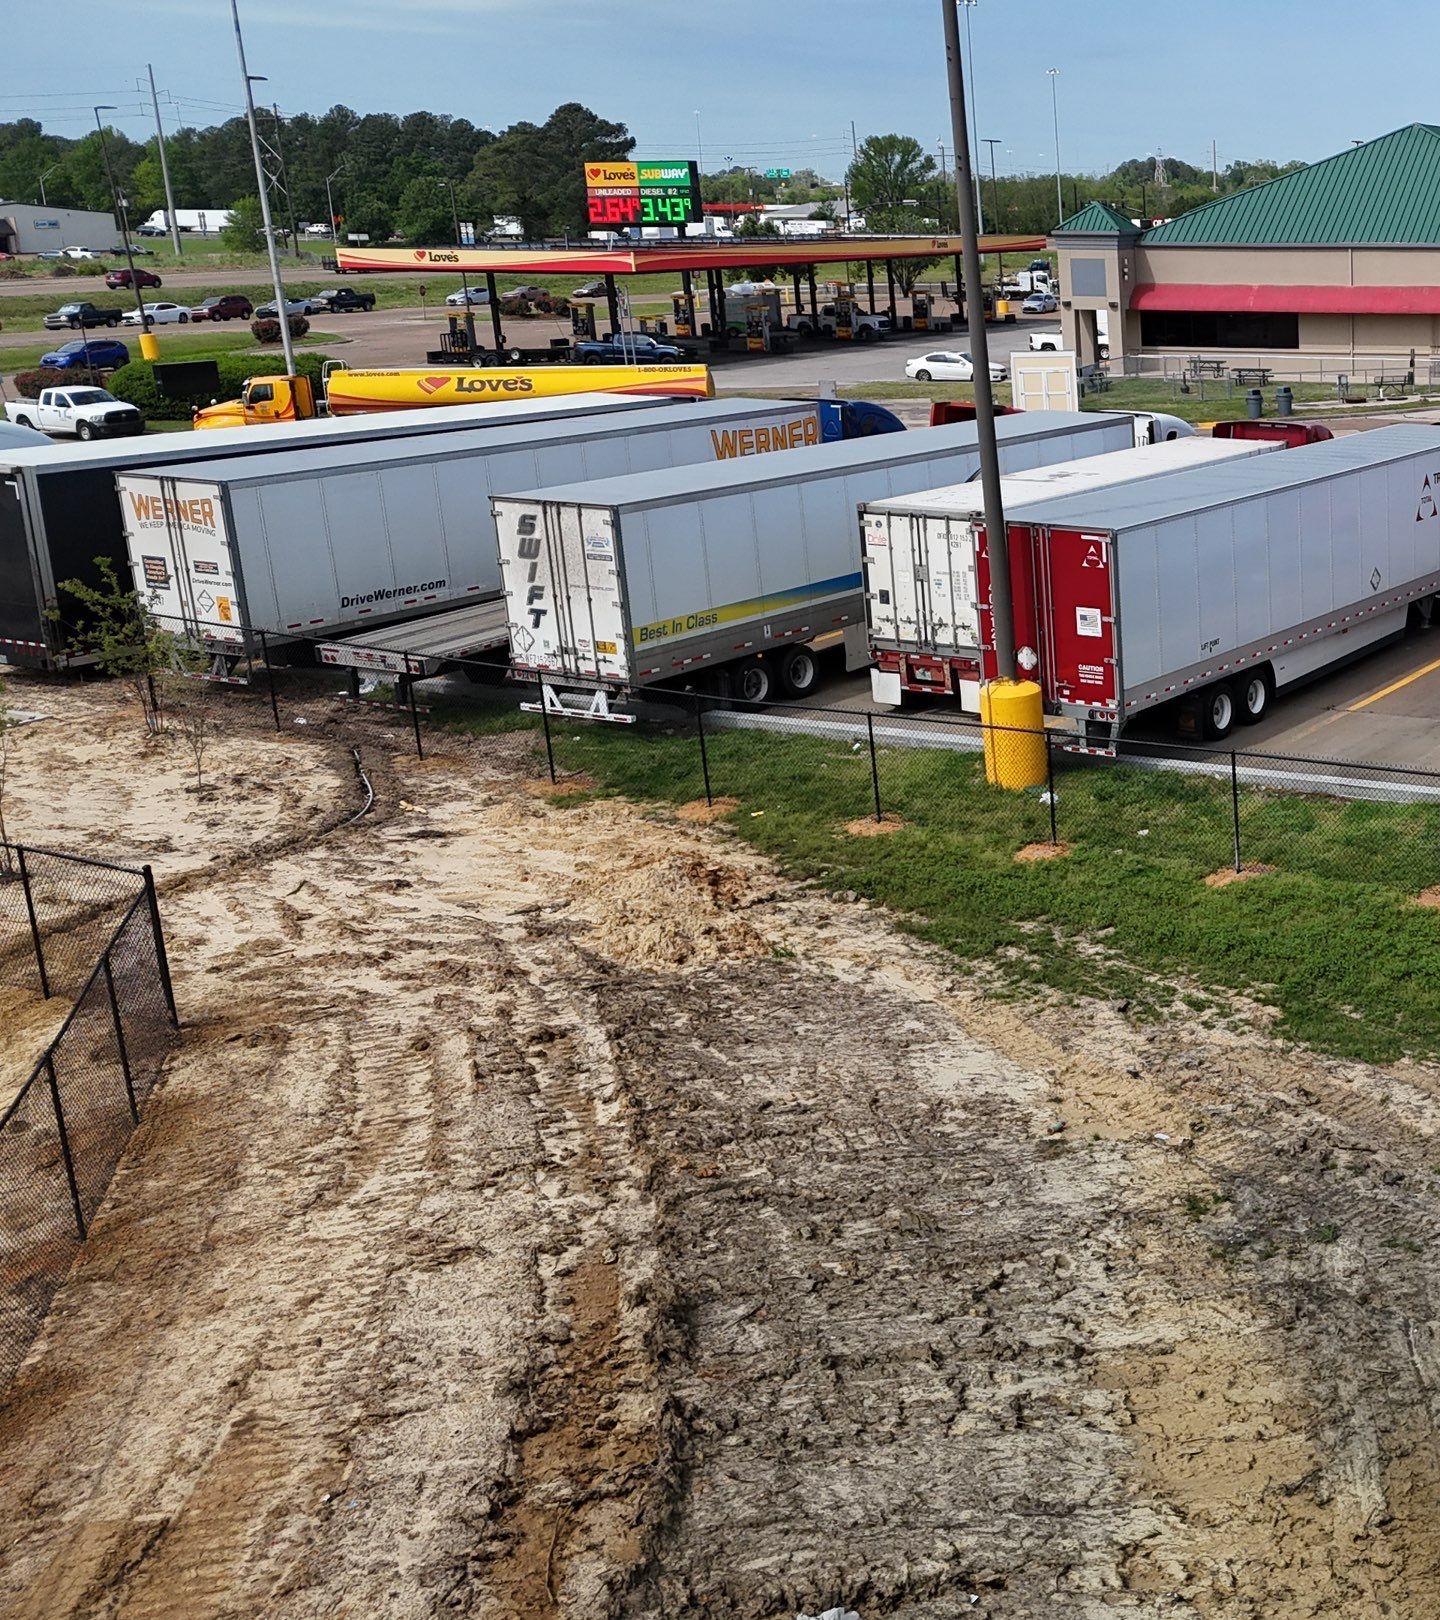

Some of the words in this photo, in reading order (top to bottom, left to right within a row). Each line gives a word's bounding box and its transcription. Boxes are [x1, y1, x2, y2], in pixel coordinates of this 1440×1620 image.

[603, 168, 636, 181] Love's
[640, 168, 688, 179] SUBWAY
[595, 188, 632, 196] UNLEADED
[640, 188, 665, 196] DIESEL
[428, 251, 460, 262] Love's
[455, 376, 534, 393] Love's
[710, 416, 818, 461] WERNER
[129, 491, 216, 528] WERNER
[191, 524, 216, 537] MOVING
[867, 534, 887, 543] Dole
[516, 513, 548, 629] SWIFT
[341, 579, 446, 608] DriveWerner.com
[639, 624, 668, 641] Best
[672, 620, 682, 633] In
[686, 613, 718, 629] Class
